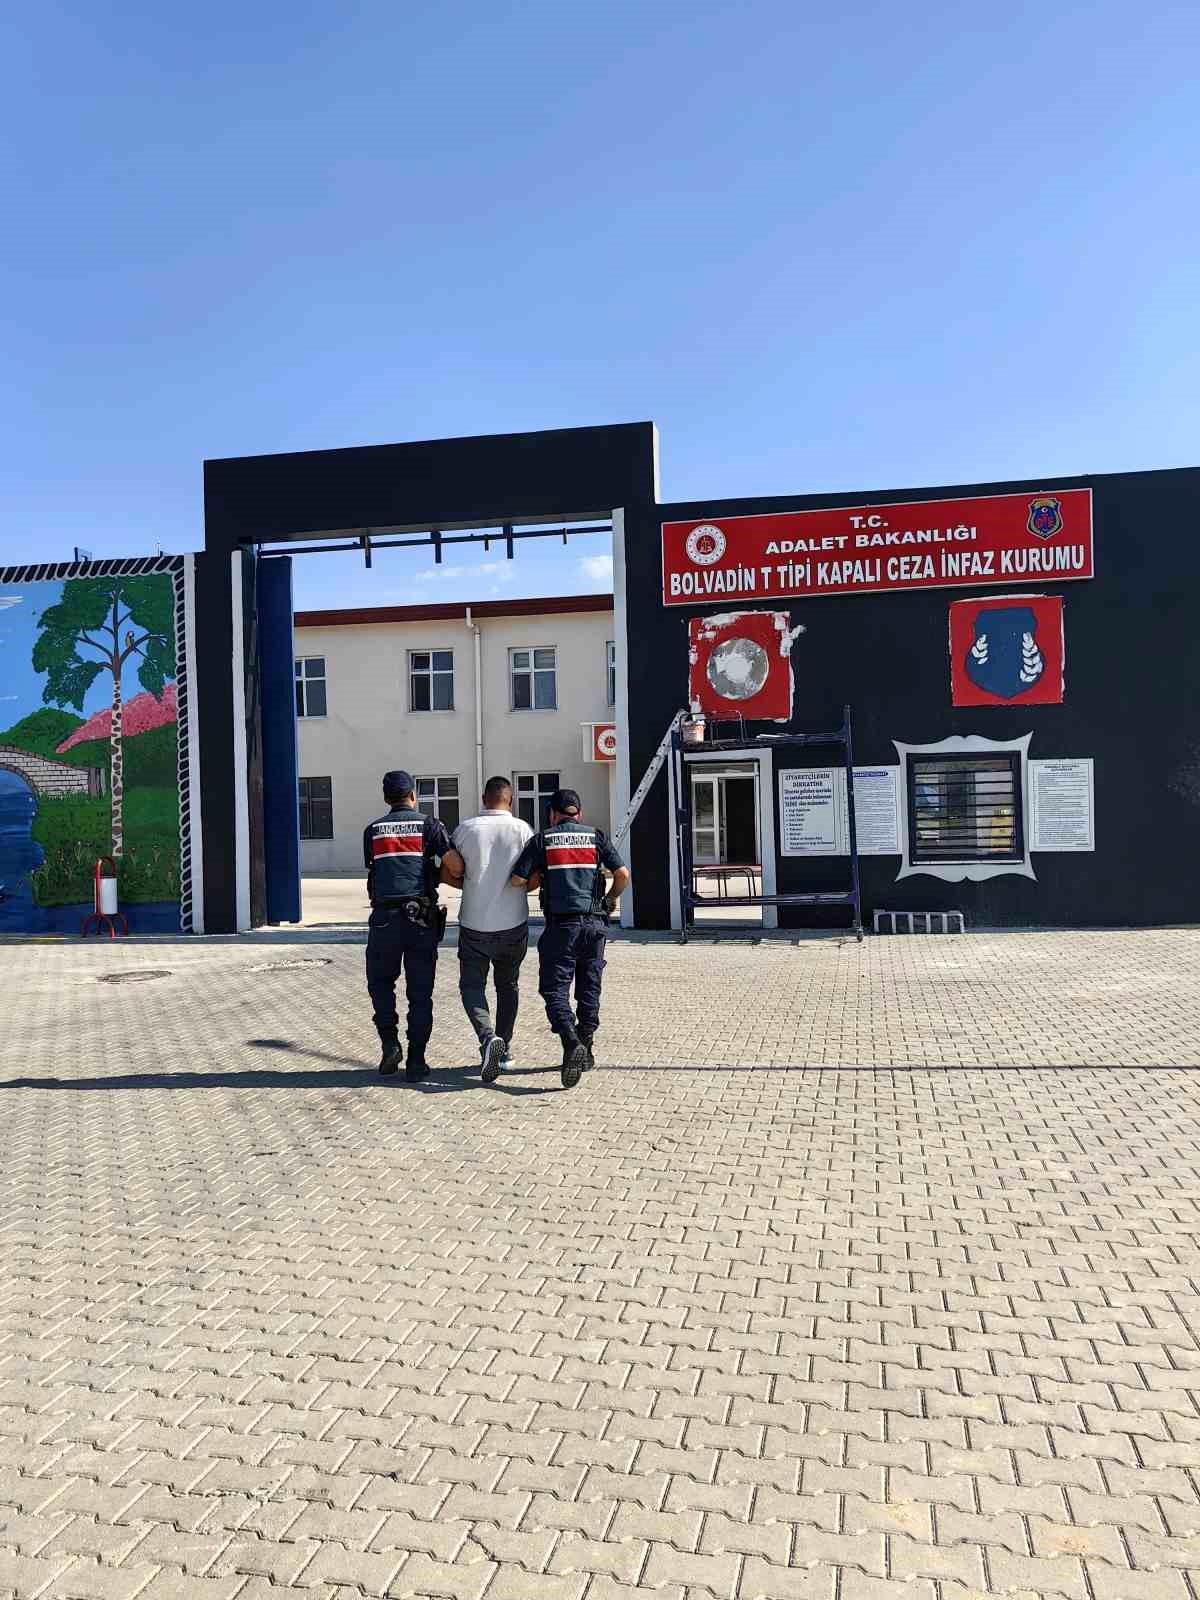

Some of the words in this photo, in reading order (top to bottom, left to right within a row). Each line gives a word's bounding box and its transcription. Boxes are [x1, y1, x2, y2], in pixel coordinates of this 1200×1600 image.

[849, 514, 889, 529] T.C.
[765, 536, 848, 554] ADALET
[855, 524, 977, 547] BAKANLIĞI
[671, 563, 756, 596] BOLVADİN
[761, 566, 773, 590] T
[777, 558, 811, 588] TİPİ
[817, 558, 881, 586] KAPALI
[887, 555, 936, 581] CEZA
[941, 548, 995, 577] İNFAZ
[1001, 544, 1084, 574] KURUMU
[377, 823, 418, 835] JANDARMA
[551, 834, 592, 846] JANDARMA
